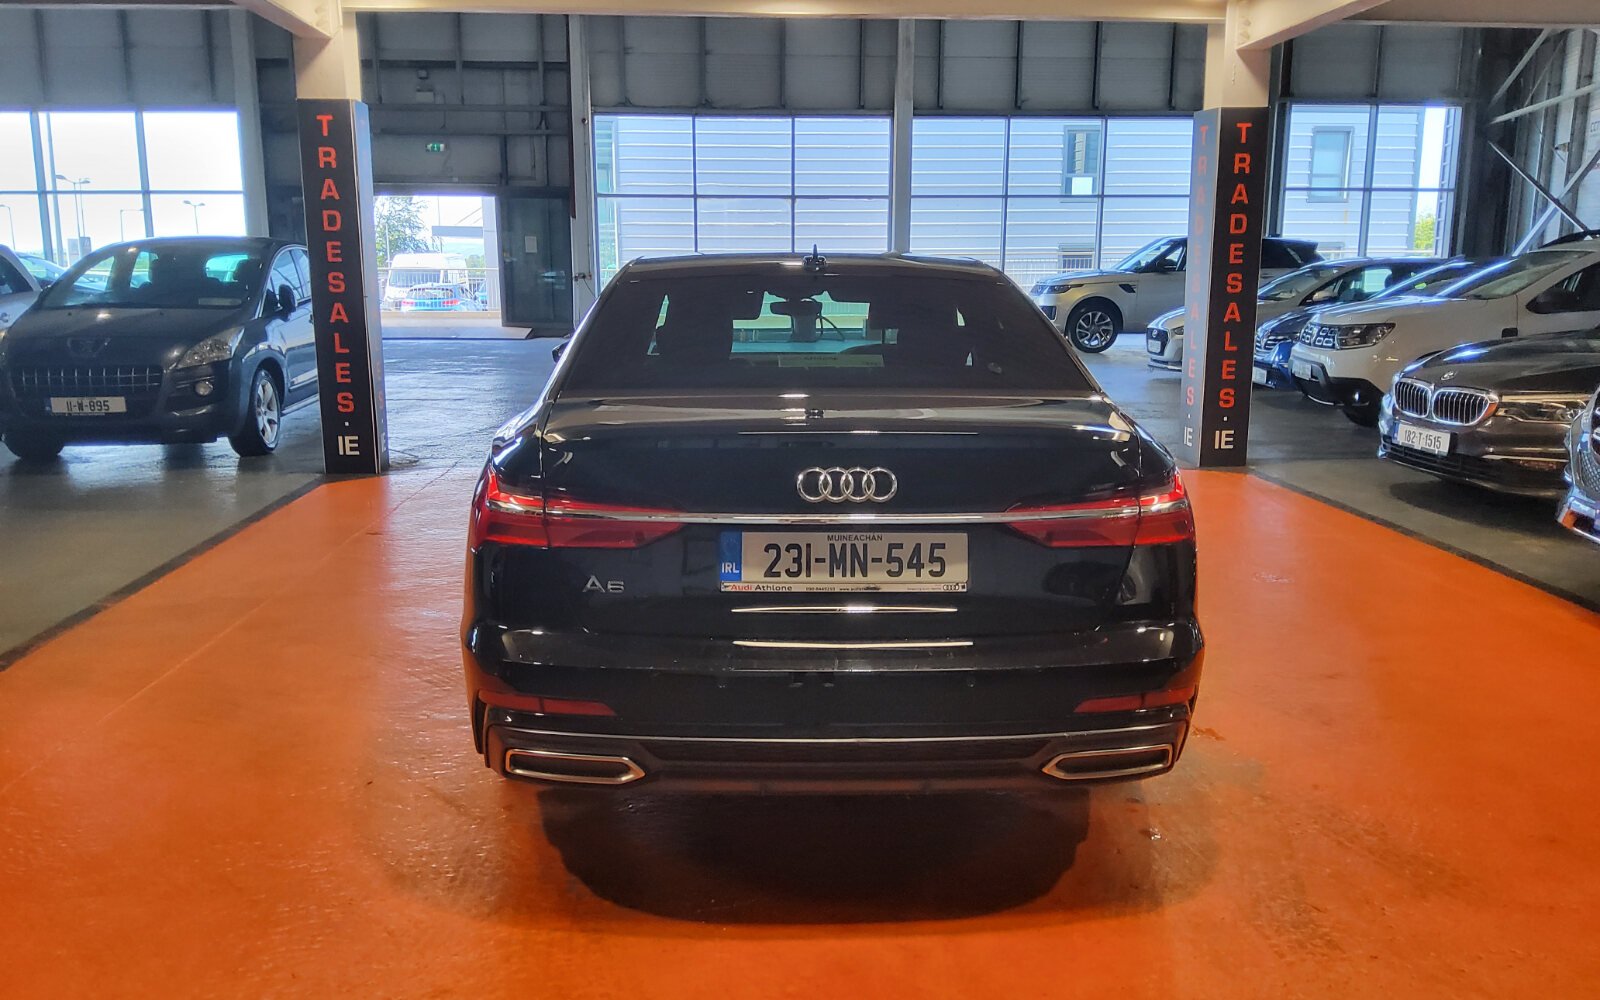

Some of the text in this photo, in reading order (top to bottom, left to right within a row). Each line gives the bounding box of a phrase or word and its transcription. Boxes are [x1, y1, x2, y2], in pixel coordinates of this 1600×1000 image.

[66, 400, 110, 412] 11-W-895
[763, 542, 946, 578] 231-MN-545
[721, 562, 740, 574] IRL
[582, 575, 625, 593] A6
[754, 584, 793, 592] Athlone
